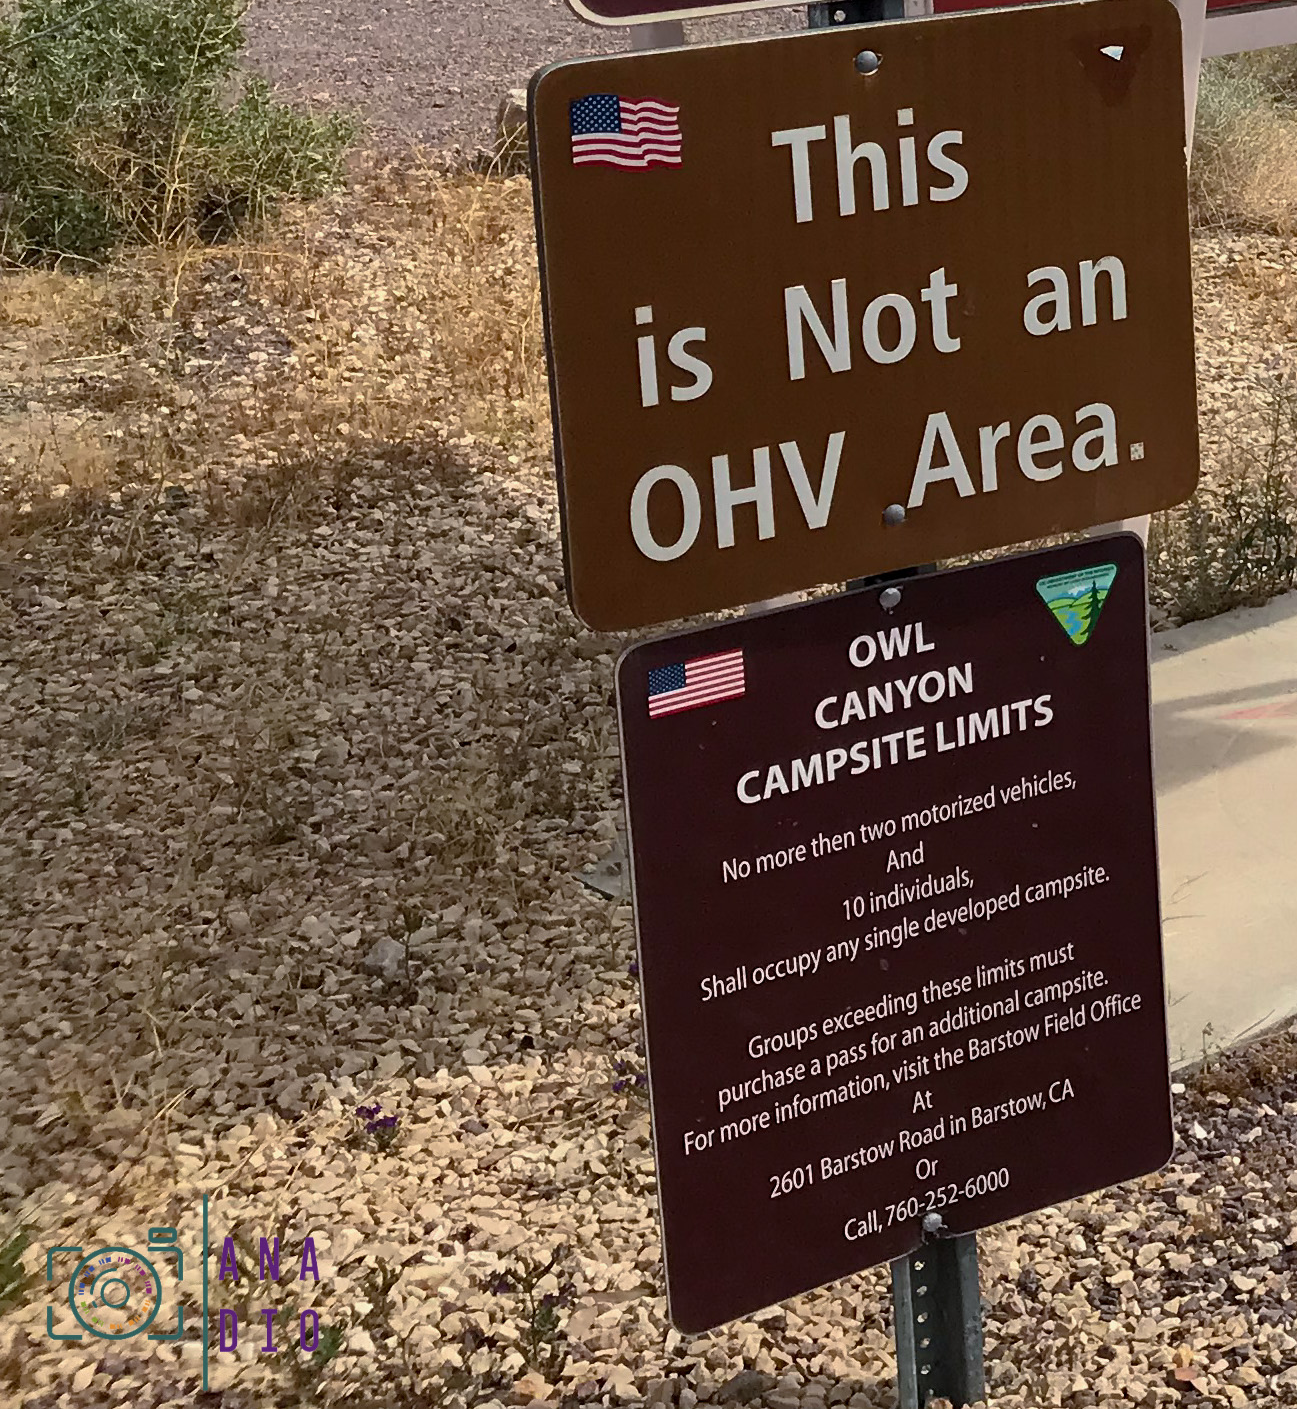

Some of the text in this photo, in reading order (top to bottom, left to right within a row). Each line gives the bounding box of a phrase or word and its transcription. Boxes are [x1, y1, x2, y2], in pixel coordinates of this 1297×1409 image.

[772, 108, 968, 223] This
[635, 256, 1126, 407] is Not an
[630, 403, 1144, 561] OHV Area.
[816, 663, 972, 729] CANYON
[849, 622, 934, 667] OWL
[737, 695, 1053, 803] CAMPSITE LIMITS
[723, 770, 1076, 883] No more then two motorized vehicles,
[887, 841, 924, 873] And
[701, 866, 1109, 1001] Shall occupy any single developed campsite.
[843, 866, 973, 920] 10 individuals,
[749, 943, 1074, 1058] Groups exceeding these limits must
[770, 1079, 1074, 1198] 2601 Barstow Road in Barstow, CA
[913, 1091, 932, 1113] At
[845, 1168, 1009, 1240] Call, 760-252-6000
[916, 1159, 938, 1179] Or
